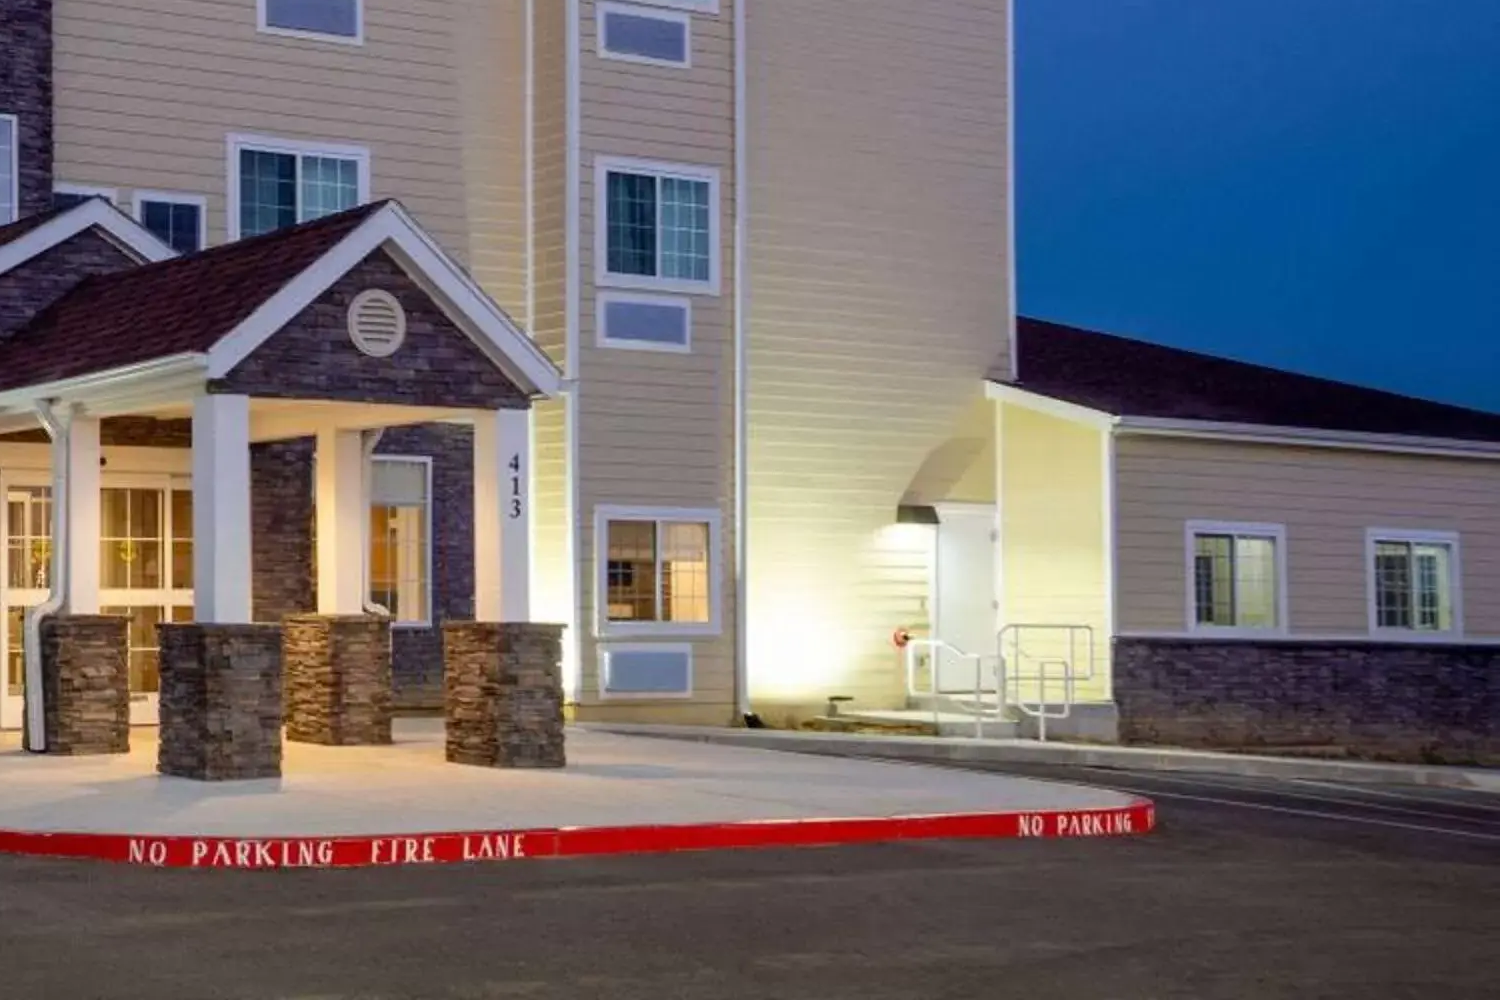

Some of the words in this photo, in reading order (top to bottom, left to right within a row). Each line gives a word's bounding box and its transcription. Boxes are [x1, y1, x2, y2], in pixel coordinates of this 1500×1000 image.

[508, 453, 521, 519] 413
[1018, 815, 1044, 837] NO
[1057, 813, 1132, 836] PARKING
[128, 839, 167, 865] NO
[192, 839, 334, 866] PARKING
[371, 838, 436, 863] FIRE
[463, 833, 526, 860] LANE
